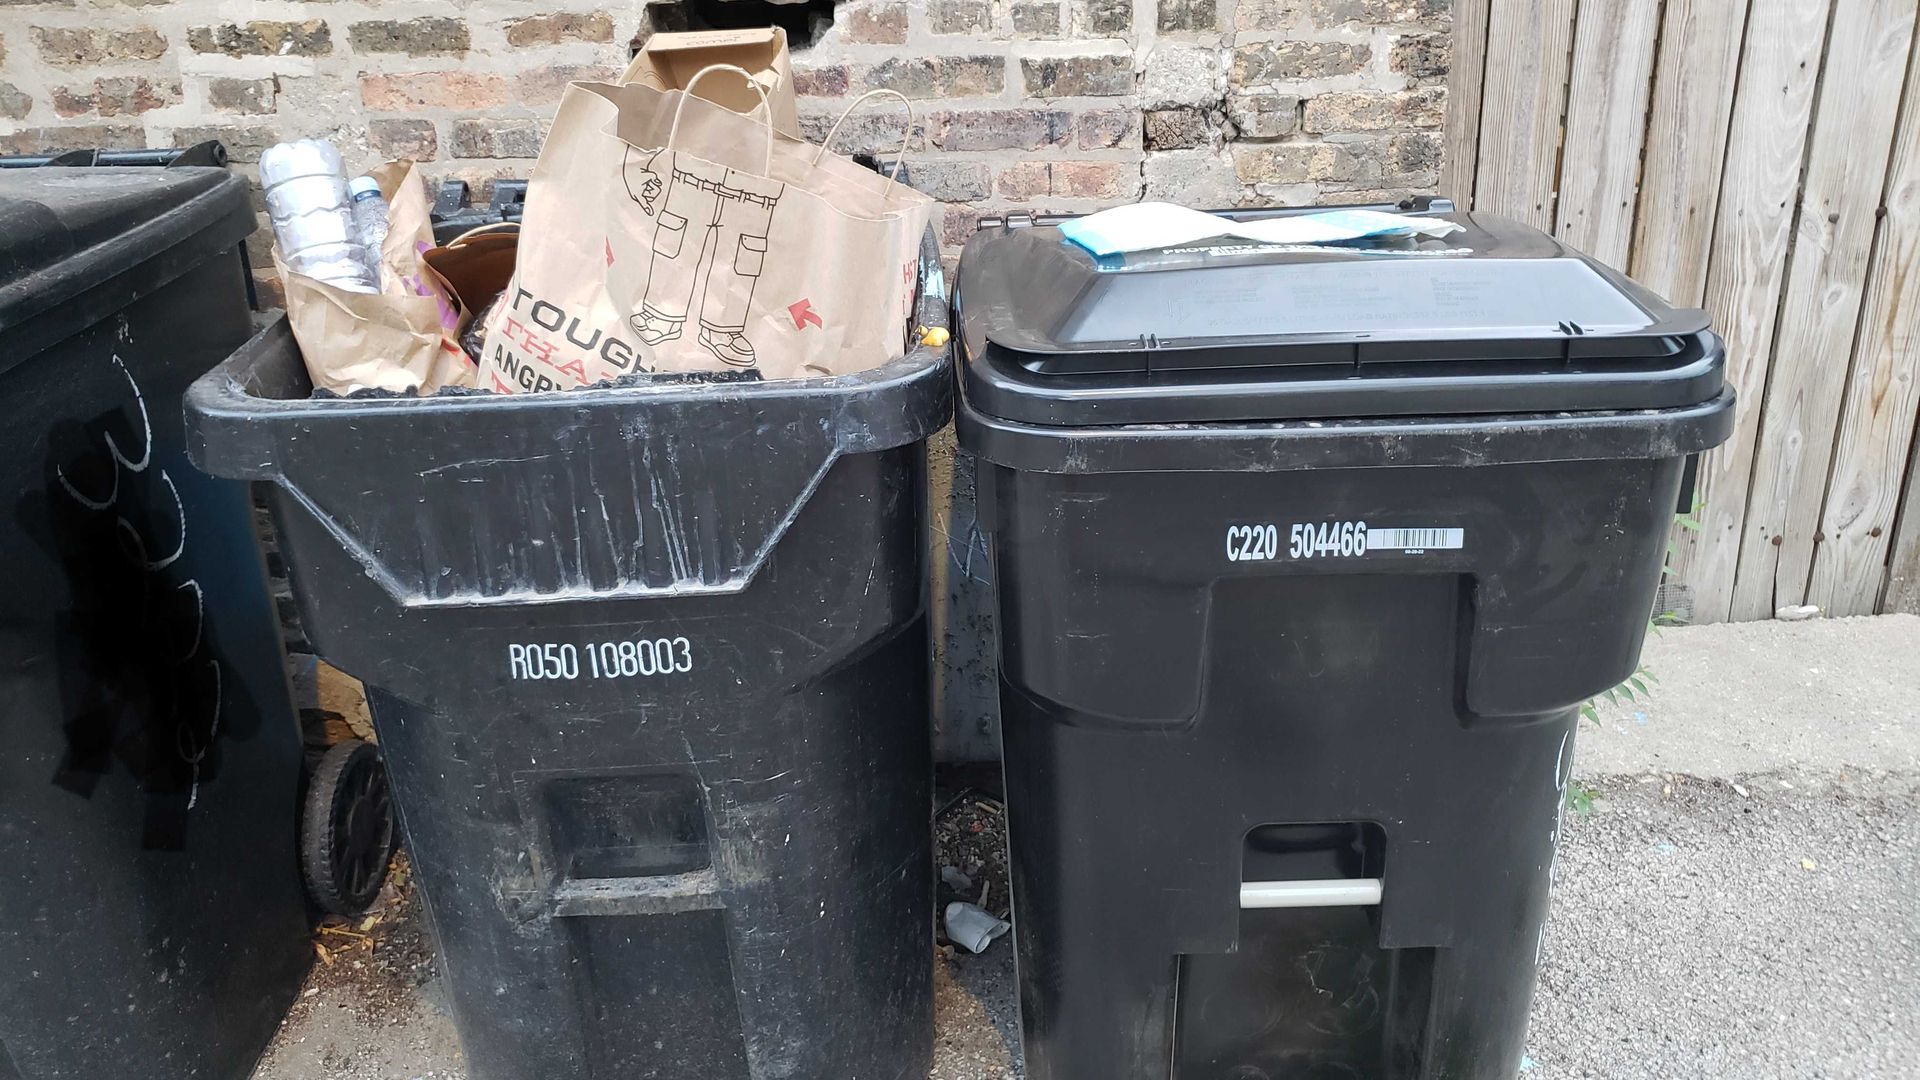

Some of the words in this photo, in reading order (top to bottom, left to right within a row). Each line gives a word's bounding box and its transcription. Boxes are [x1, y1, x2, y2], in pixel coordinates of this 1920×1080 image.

[502, 317, 613, 386] THA
[512, 287, 660, 374] TOUGH
[494, 344, 563, 394] ANGR
[1226, 525, 1278, 561] C220
[1290, 521, 1367, 558] 504466
[585, 636, 692, 679] 108003
